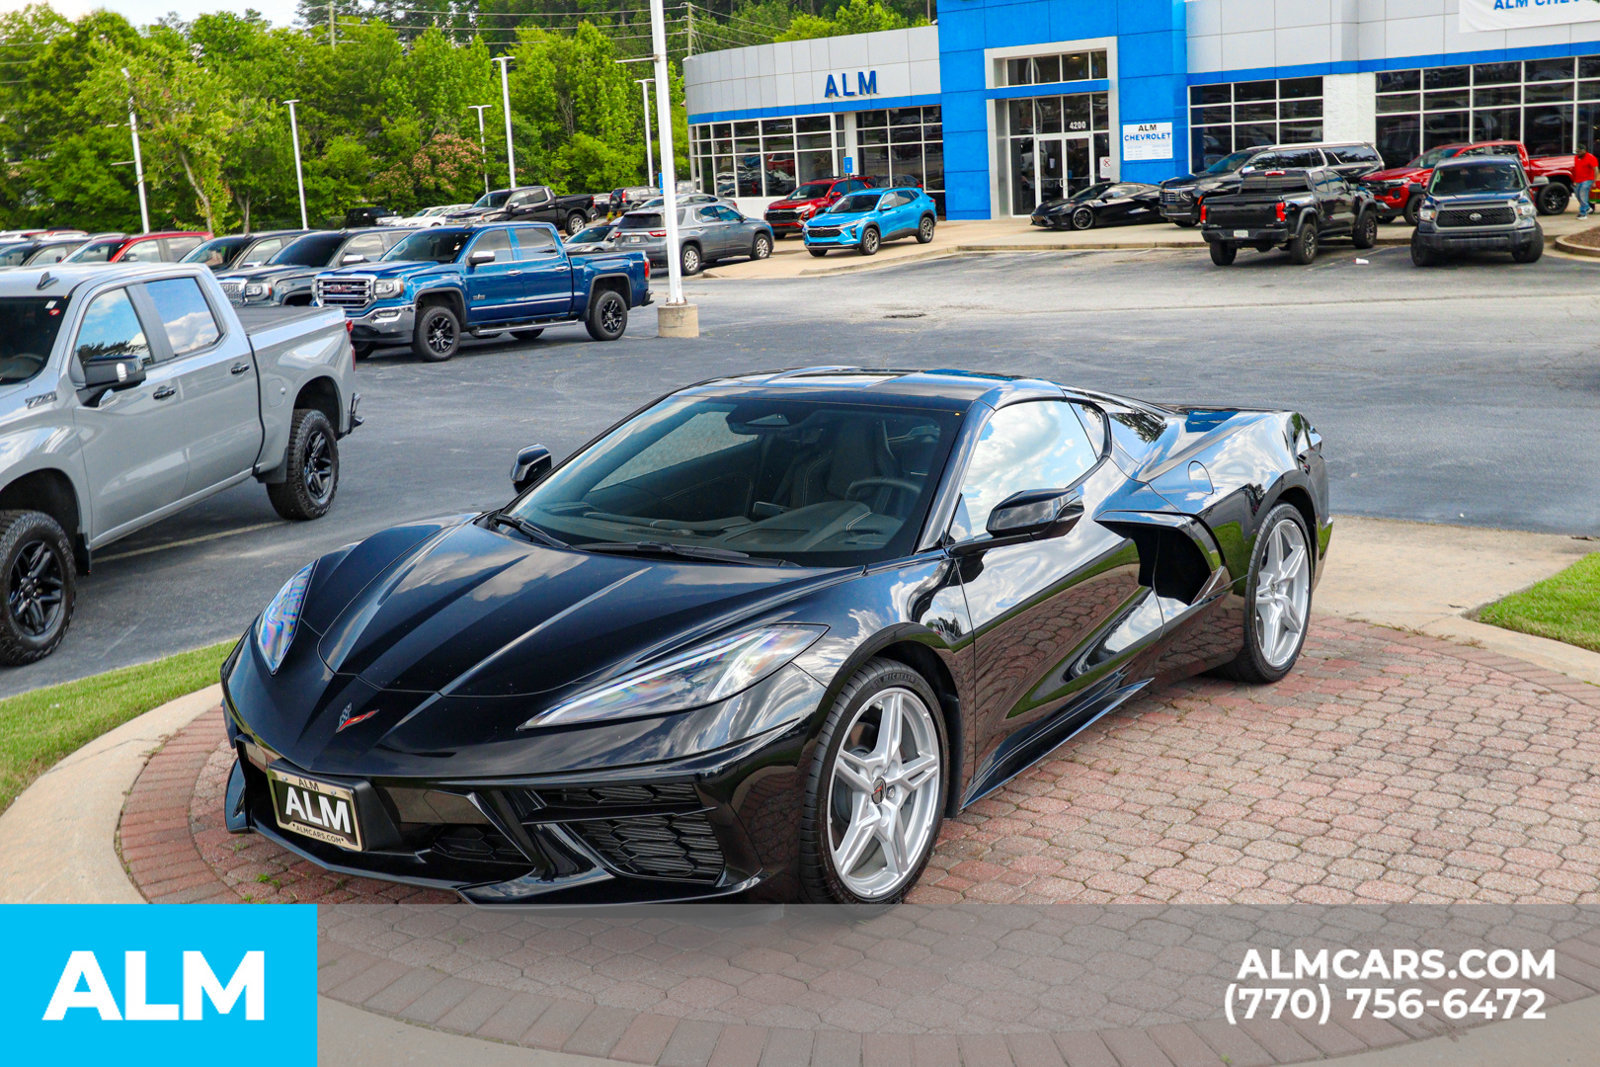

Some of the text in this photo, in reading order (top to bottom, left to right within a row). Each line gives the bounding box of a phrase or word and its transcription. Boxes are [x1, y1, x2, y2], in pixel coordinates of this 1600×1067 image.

[824, 70, 877, 98] ALM
[1069, 121, 1086, 130] 4200
[1138, 124, 1157, 132] ALM
[1124, 132, 1171, 141] CHEVROLET
[298, 778, 320, 791] ALM
[285, 786, 351, 833] ALM
[296, 825, 342, 844] ALMCARS.COM
